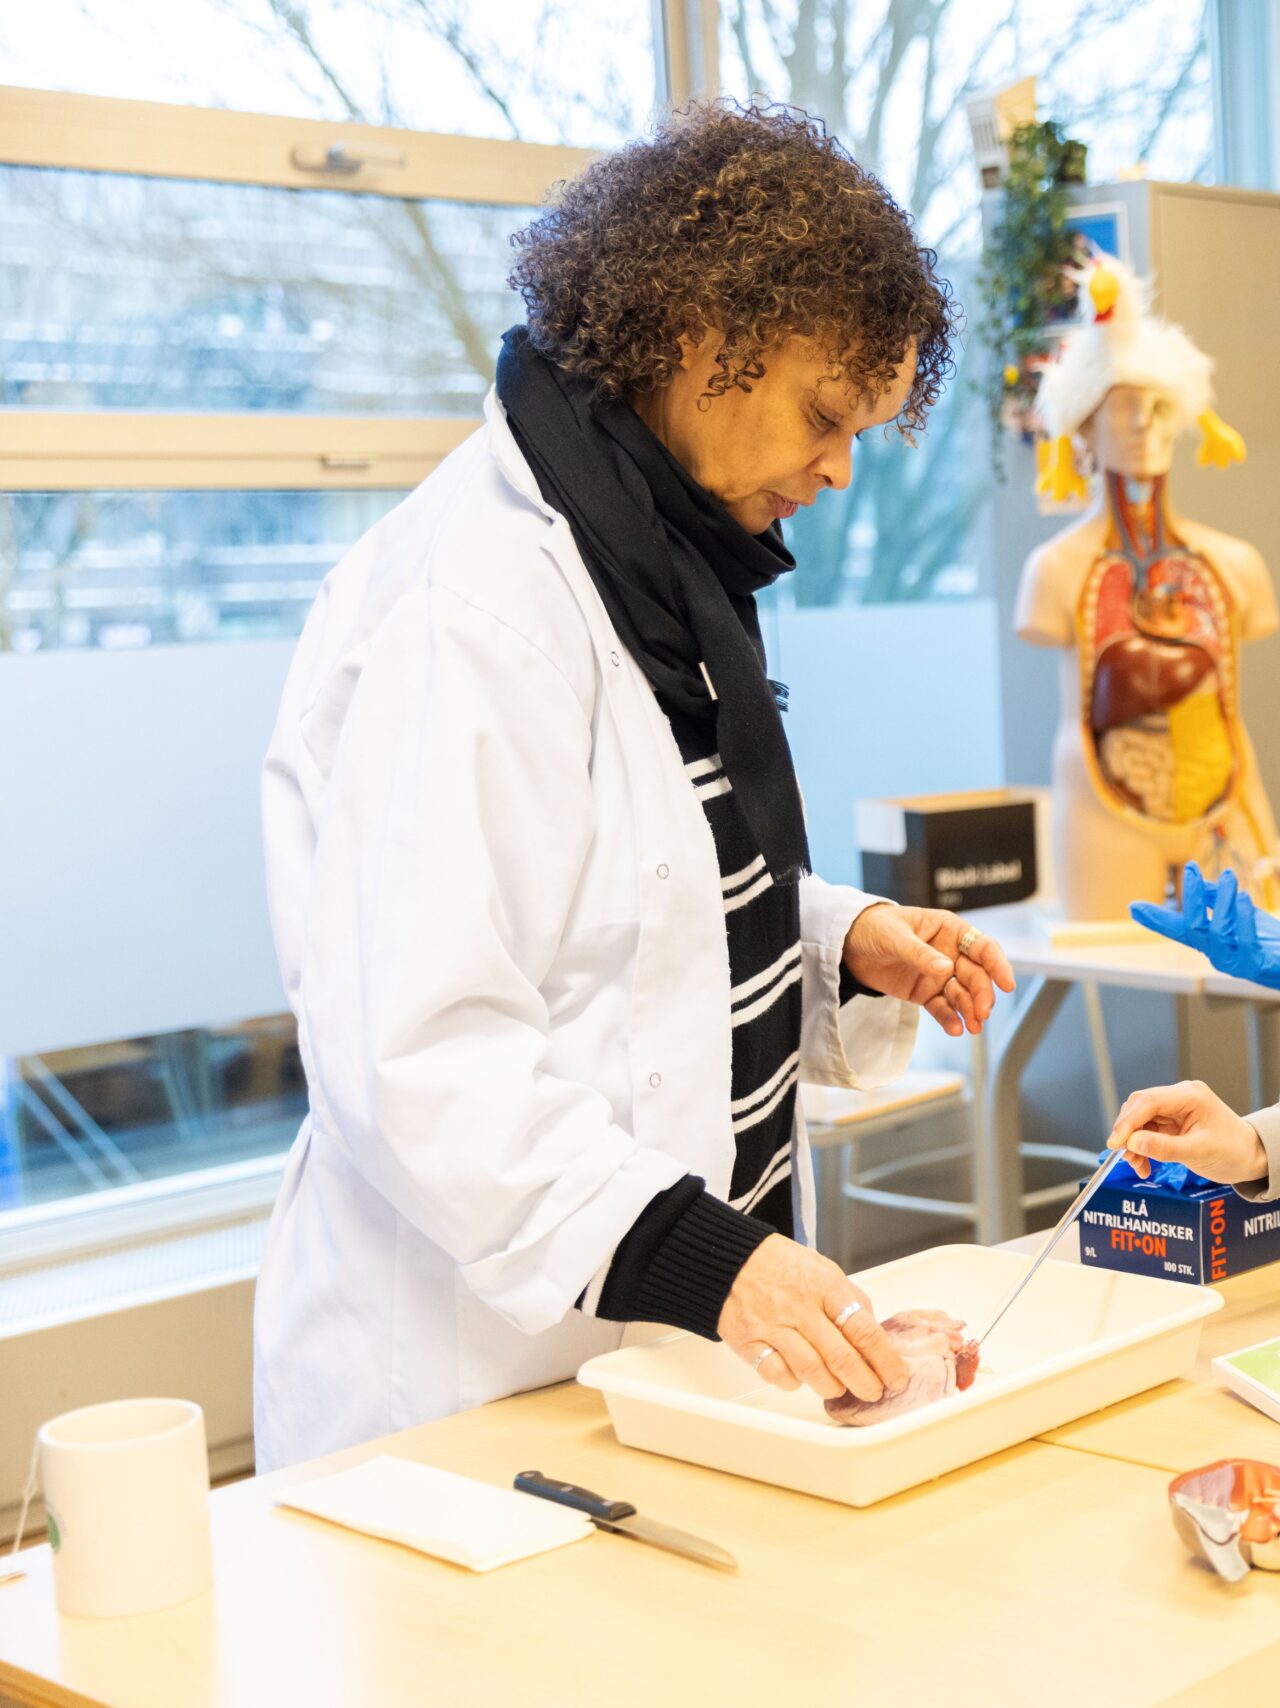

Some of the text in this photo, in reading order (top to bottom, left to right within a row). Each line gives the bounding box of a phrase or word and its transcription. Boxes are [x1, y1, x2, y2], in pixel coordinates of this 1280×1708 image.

[1122, 1199, 1149, 1217] BLÅ
[1083, 1210, 1194, 1241] NITRILHANDSKER
[1164, 1261, 1195, 1276] 100 STK.
